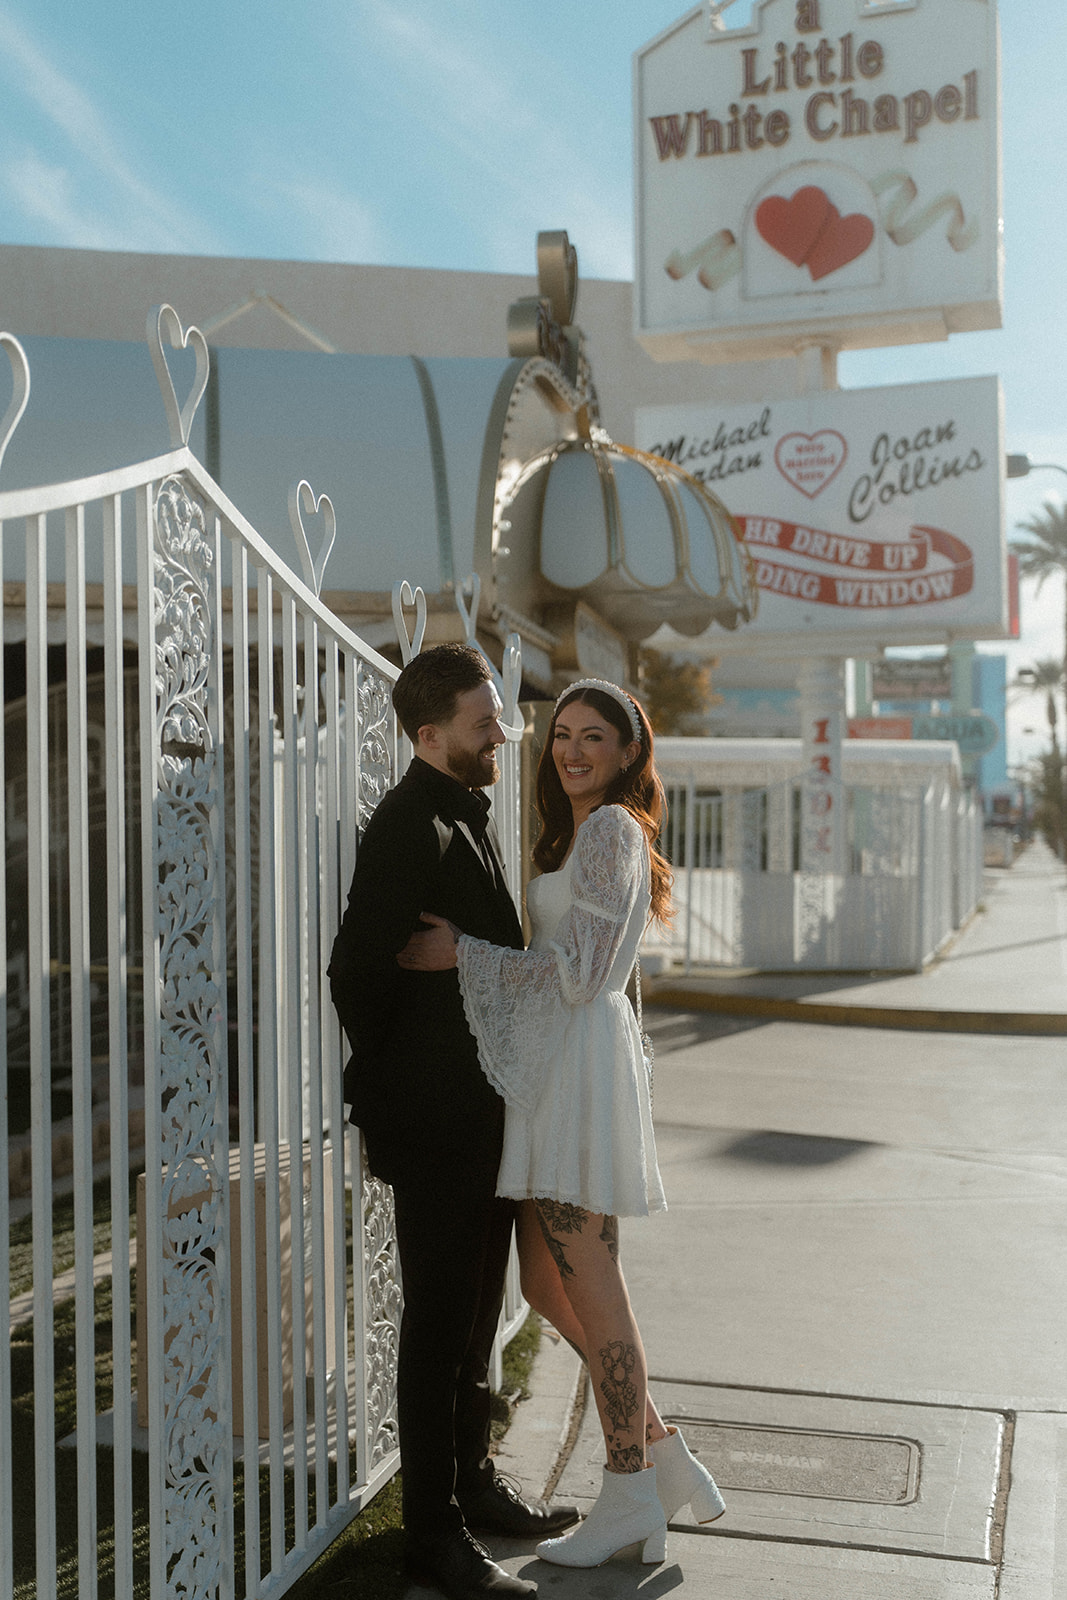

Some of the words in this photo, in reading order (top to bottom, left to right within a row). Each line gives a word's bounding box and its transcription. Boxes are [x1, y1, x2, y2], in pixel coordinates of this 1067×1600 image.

[795, 0, 822, 33] a
[741, 32, 884, 98] Little
[649, 102, 791, 163] White
[805, 69, 980, 143] Chapel
[648, 404, 771, 465] Michael
[870, 419, 956, 484] Joan
[694, 450, 763, 482] rdan
[848, 447, 985, 524] Collins
[743, 516, 782, 546] HR
[791, 525, 872, 568] DRIVE
[883, 545, 920, 570] UP
[756, 562, 822, 600] DING
[834, 572, 955, 607] WINDOW
